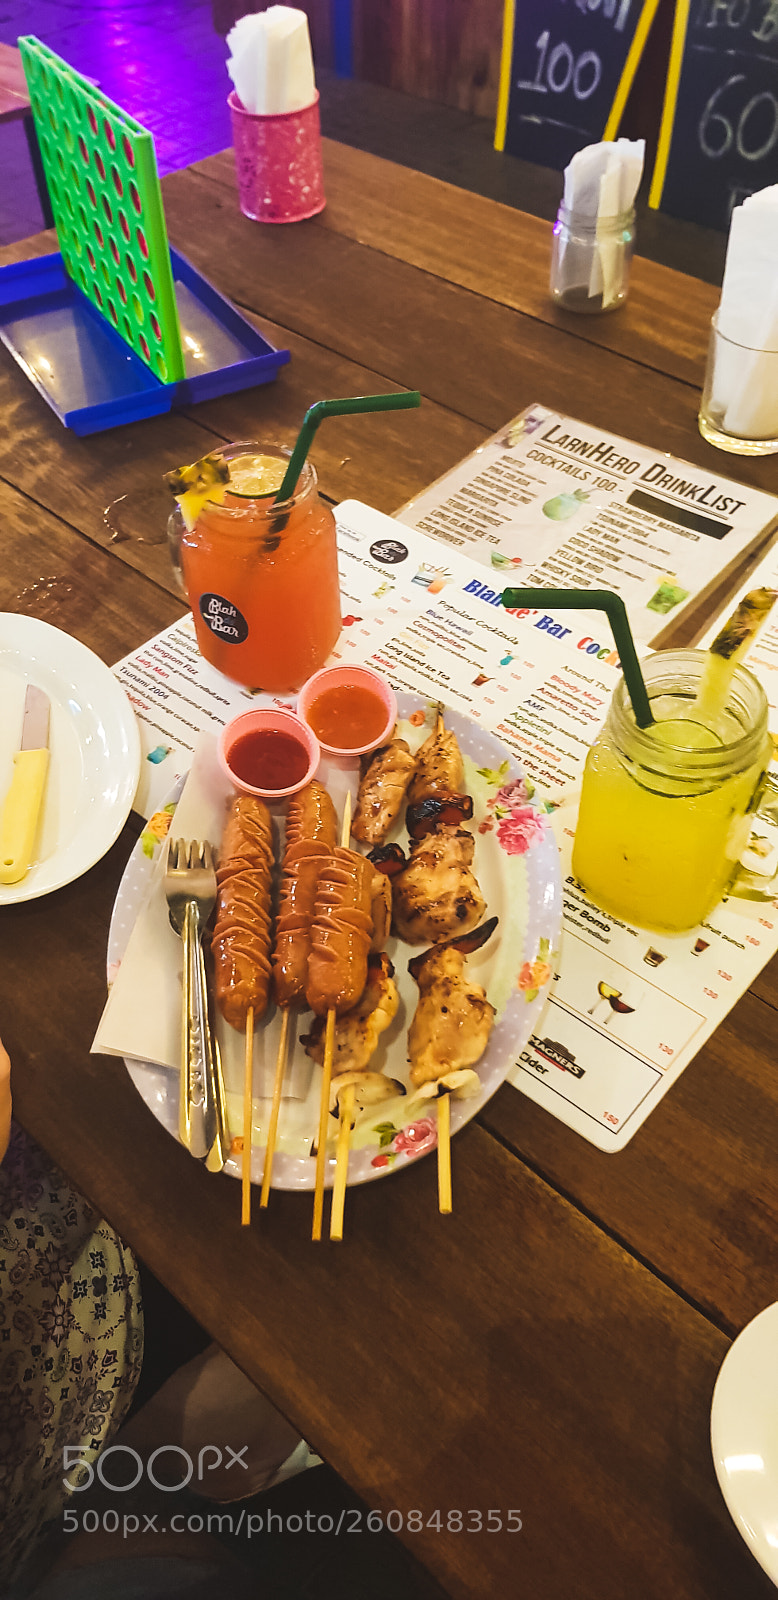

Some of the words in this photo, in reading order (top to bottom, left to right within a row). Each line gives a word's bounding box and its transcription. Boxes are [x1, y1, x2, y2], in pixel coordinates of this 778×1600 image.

[517, 31, 601, 99] 100
[526, 449, 593, 481] COCKTAILS
[486, 535, 501, 544] TEA
[208, 598, 237, 618] Blah
[206, 614, 239, 637] Bar
[438, 600, 474, 620] Popular
[476, 620, 518, 645] Cocktails
[533, 615, 573, 640] Bar
[577, 637, 622, 669] Cock
[151, 644, 183, 665] Sangsom
[385, 643, 403, 655] Long
[403, 653, 425, 666] Island
[437, 671, 450, 680] Tea
[135, 655, 153, 668] Lady
[152, 666, 170, 678] Man
[120, 666, 150, 687] Tsunami
[148, 686, 169, 699] 2004
[550, 675, 581, 693] Bloody
[595, 681, 611, 692] The
[523, 700, 546, 711] AMF
[536, 688, 578, 711] Amaretto
[579, 709, 600, 722] Sour
[510, 712, 552, 735] Appletini
[496, 724, 532, 746] Bahama
[533, 744, 561, 762] Mama
[523, 760, 539, 771] the
[539, 770, 566, 786] sheet
[579, 910, 610, 932] Bomb
[528, 1036, 584, 1076] MAGNERS
[658, 1042, 674, 1056] 130
[519, 1052, 550, 1075] Cider
[603, 1111, 619, 1125] 150
